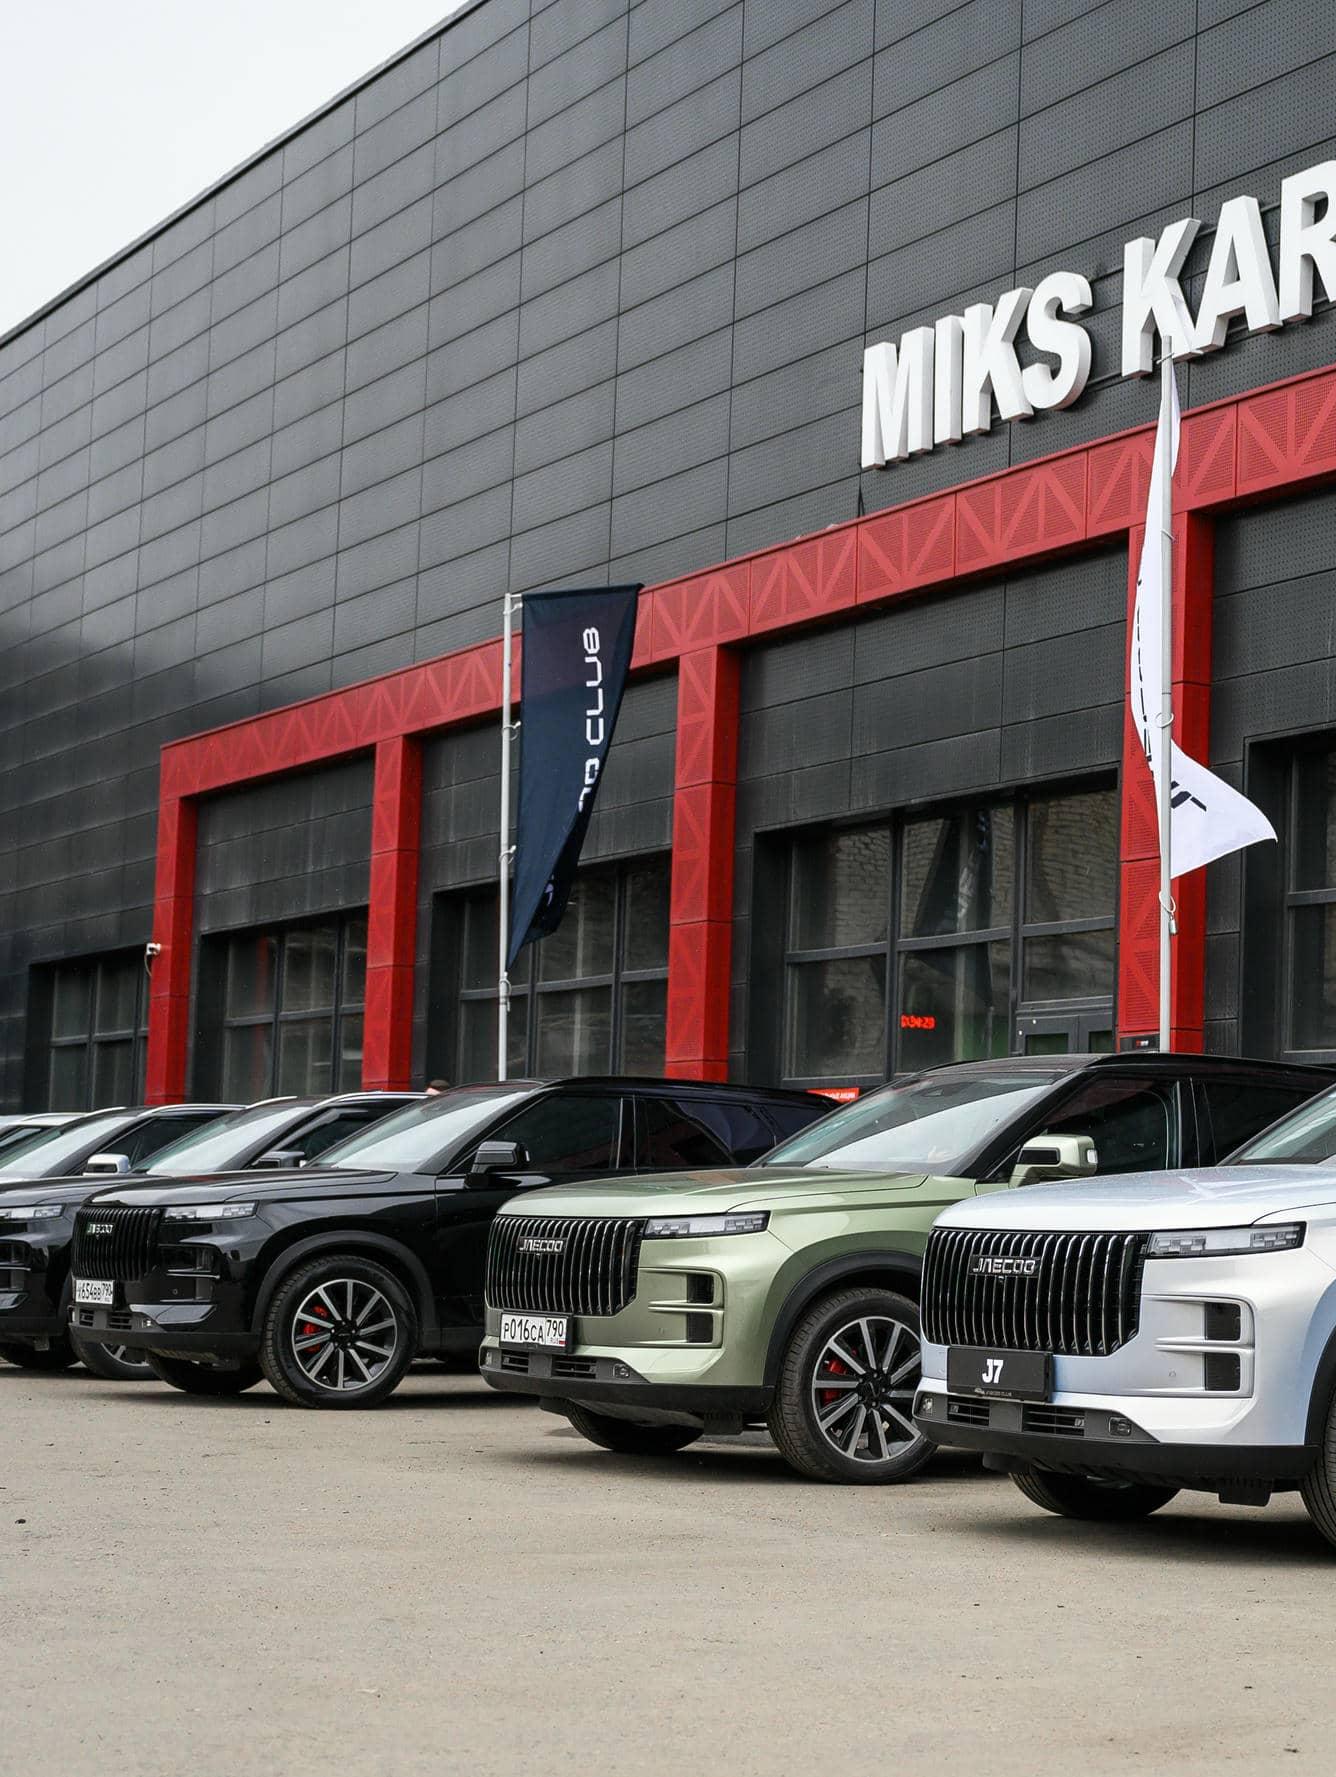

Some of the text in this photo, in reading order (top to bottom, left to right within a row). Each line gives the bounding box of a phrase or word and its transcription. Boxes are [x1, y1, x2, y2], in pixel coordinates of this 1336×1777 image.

[860, 271, 1093, 471] MIKS
[583, 627, 604, 745] CLUB
[519, 1239, 564, 1252] JAECOO
[973, 1257, 1036, 1274] JAECOO
[546, 1319, 565, 1338] 790
[982, 1359, 1004, 1383] J7
